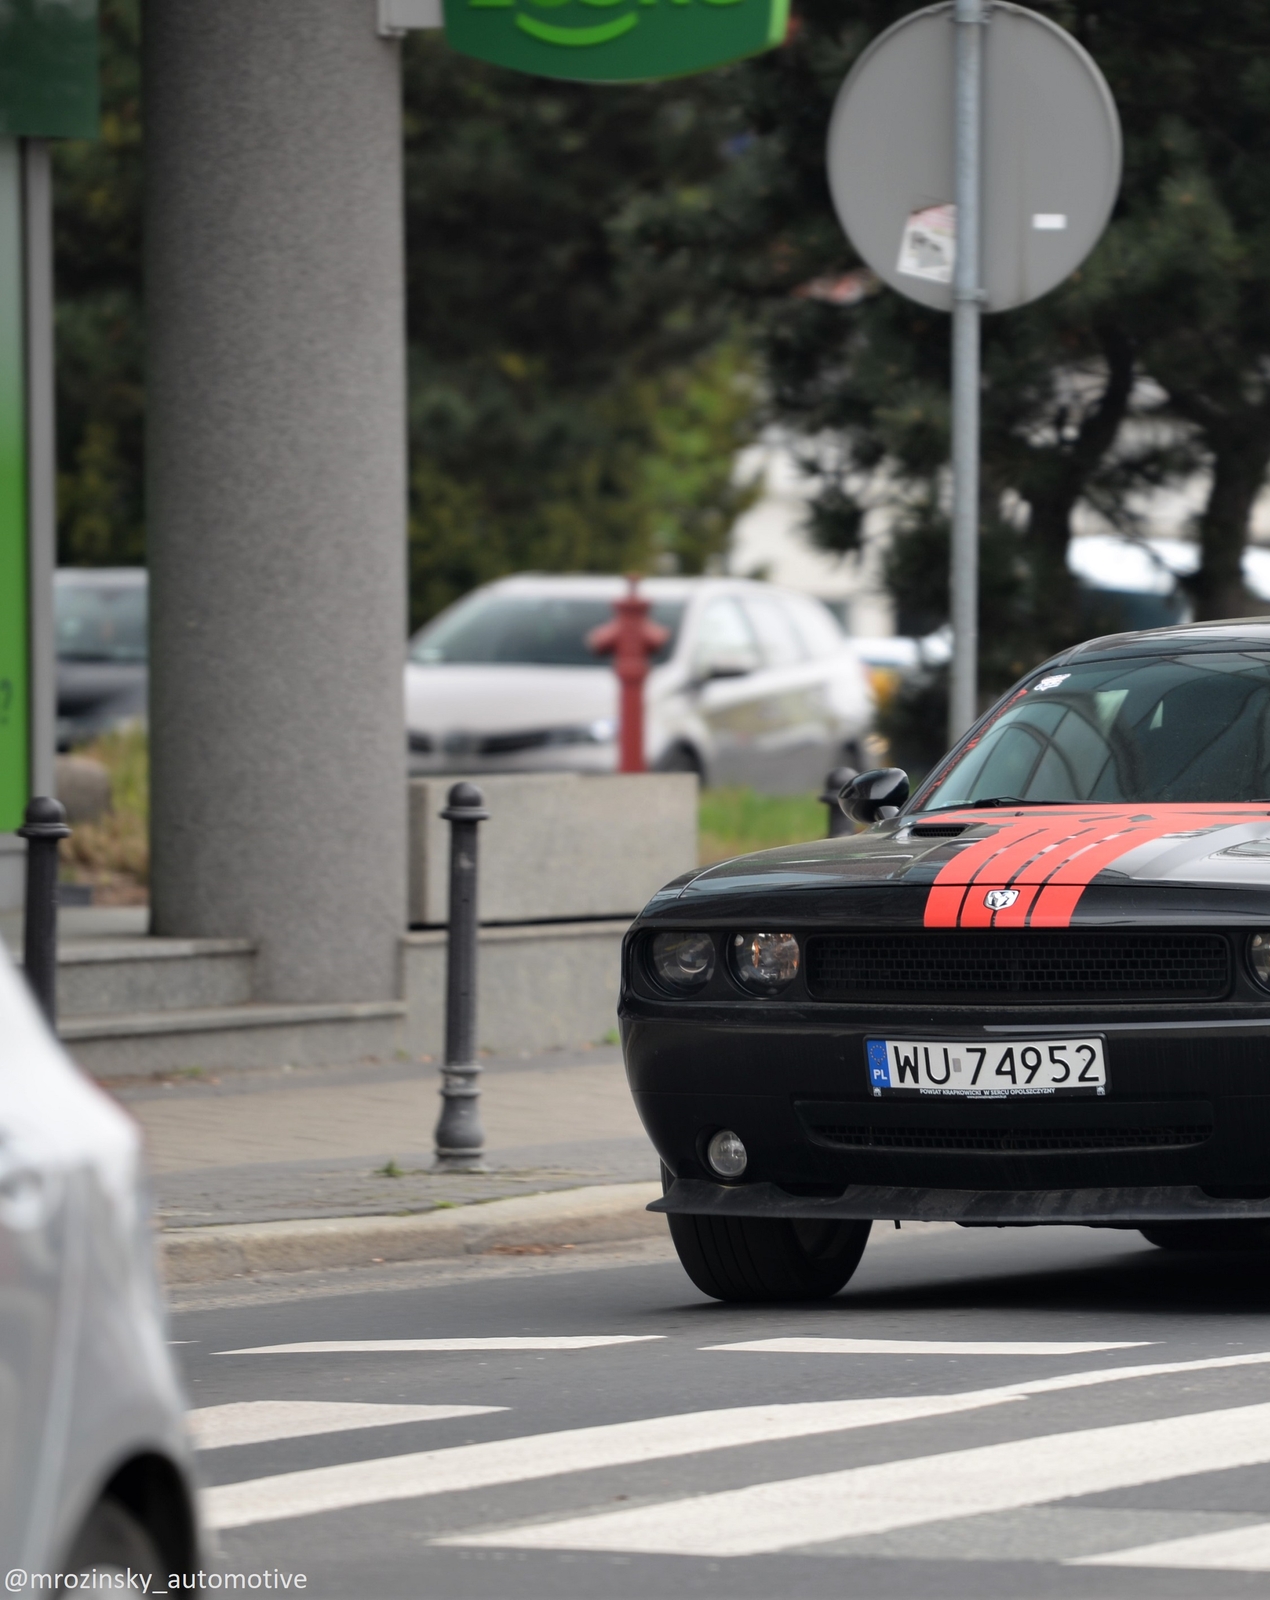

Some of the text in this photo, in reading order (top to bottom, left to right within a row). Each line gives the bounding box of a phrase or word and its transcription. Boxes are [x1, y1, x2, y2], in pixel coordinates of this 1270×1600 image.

[894, 1044, 1100, 1086] WU 74952
[873, 1069, 888, 1080] PL
[919, 1088, 942, 1096] POWIAT
